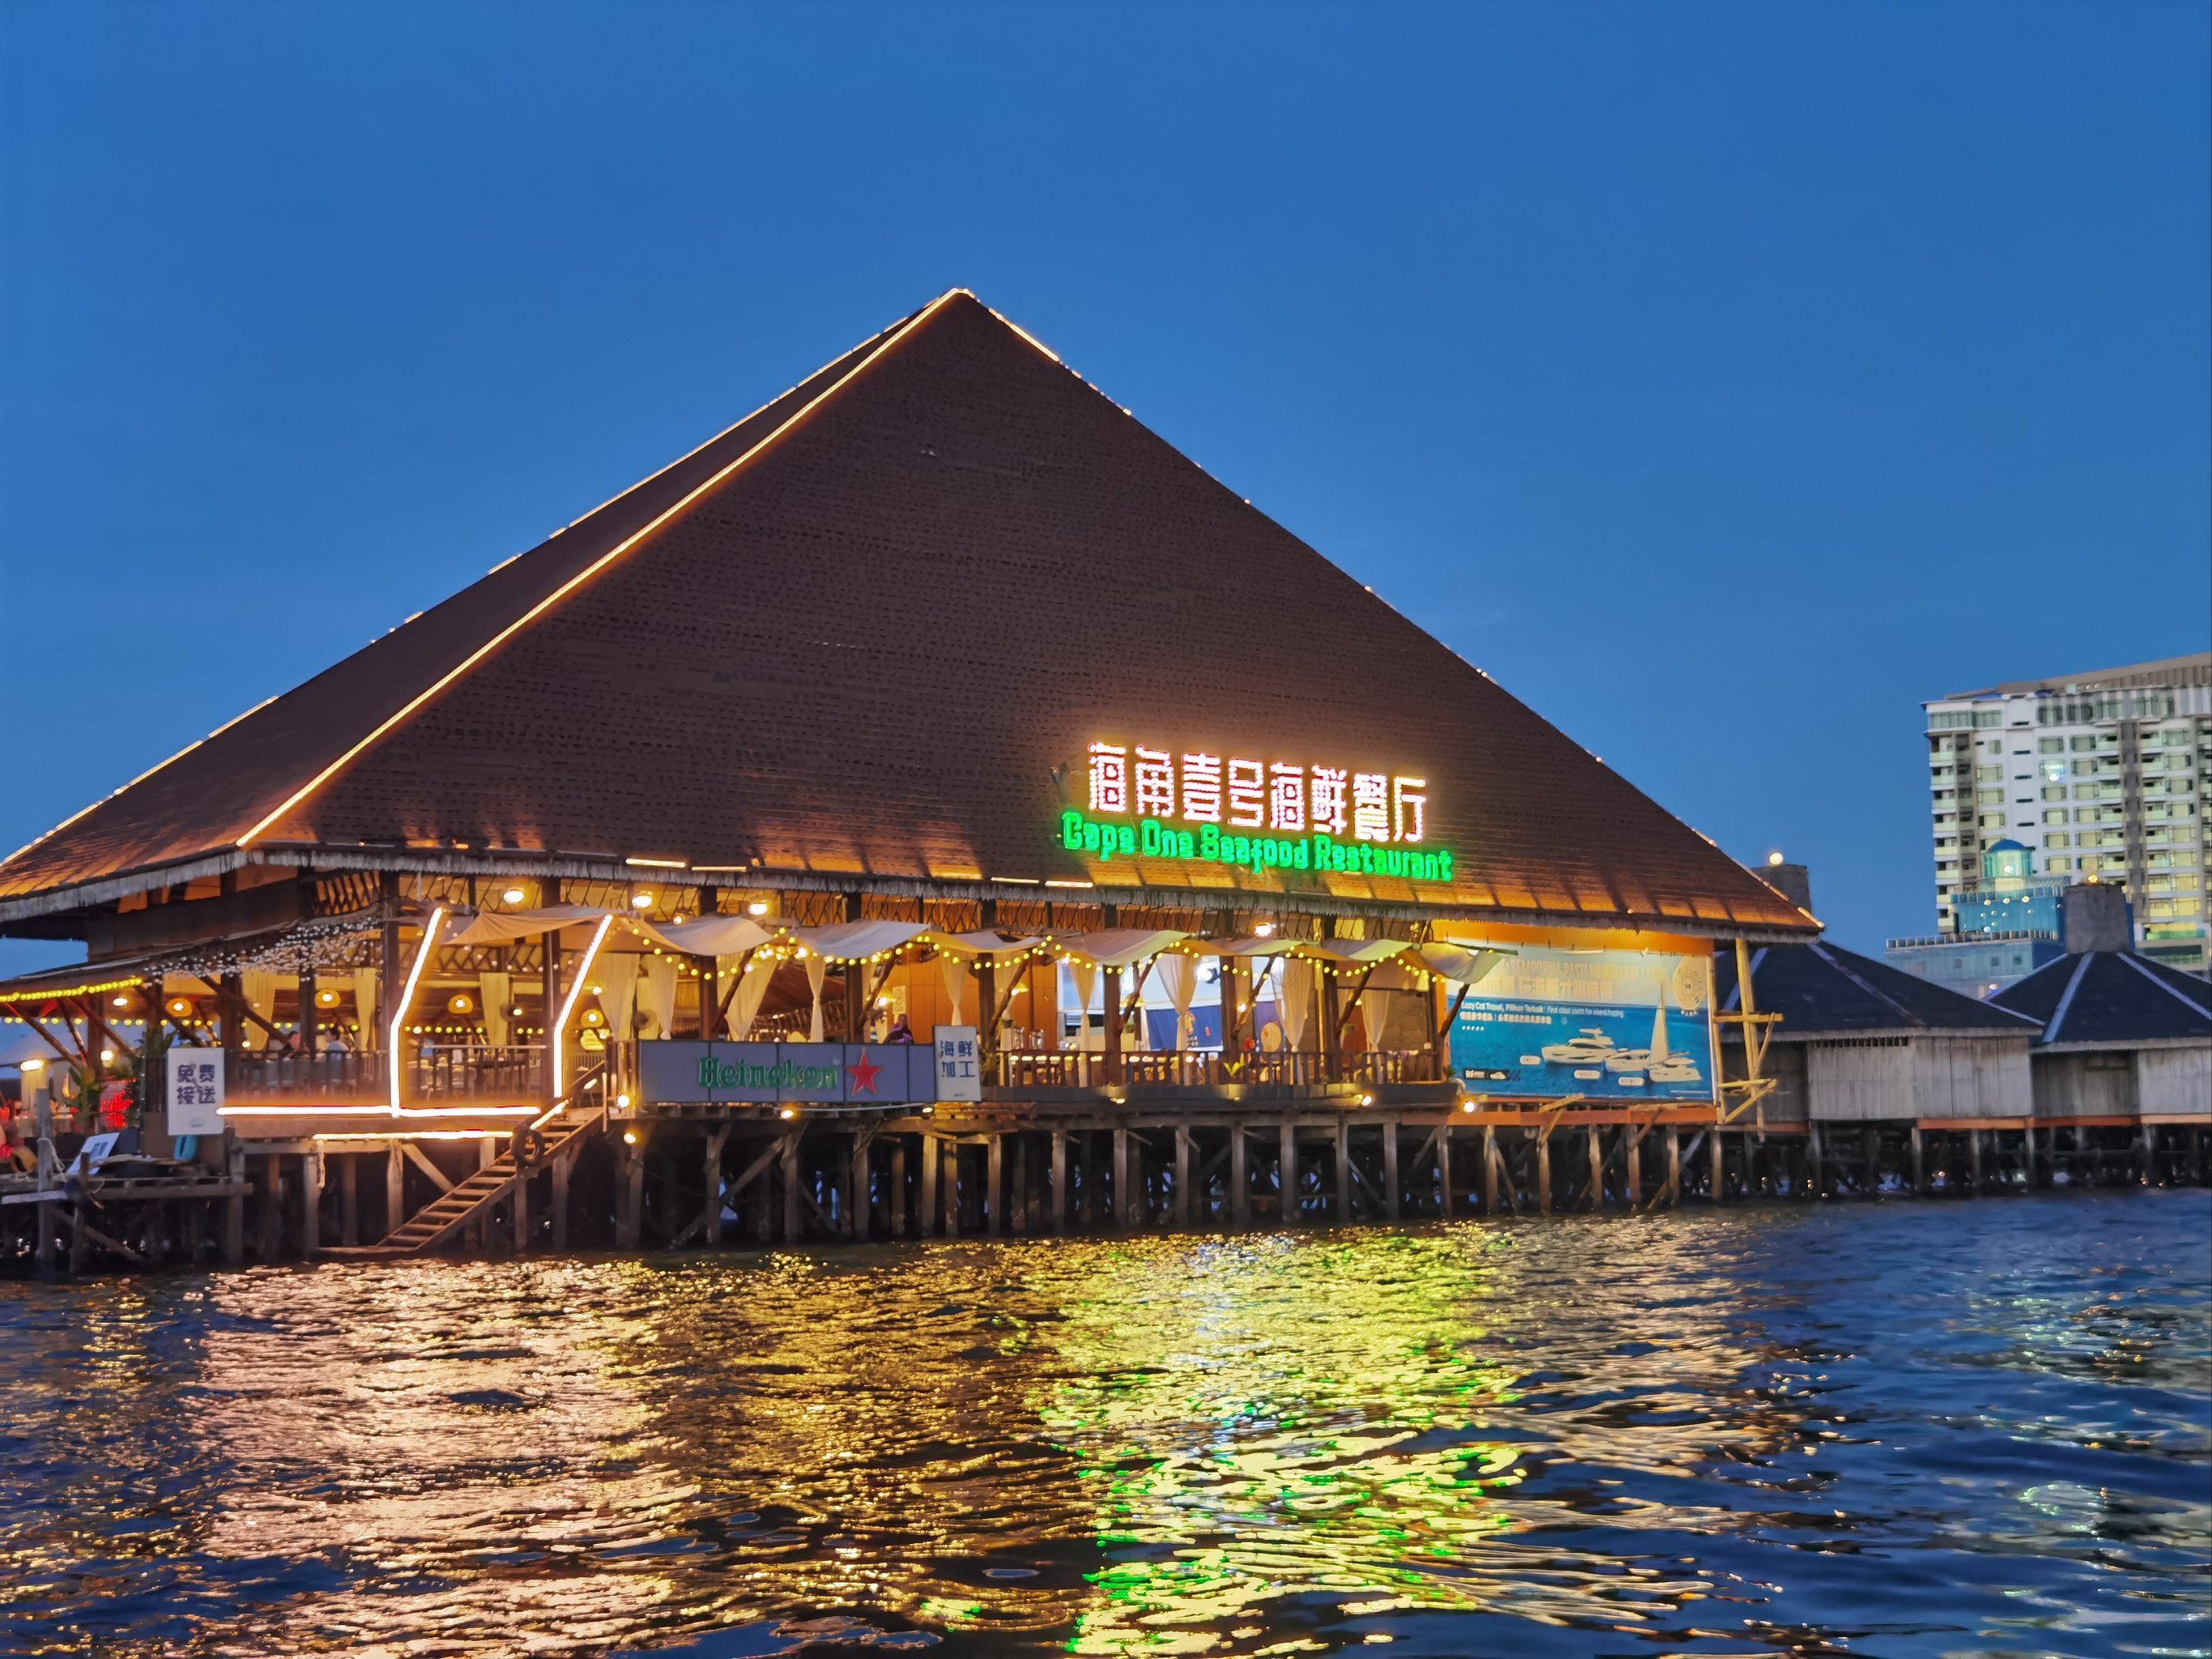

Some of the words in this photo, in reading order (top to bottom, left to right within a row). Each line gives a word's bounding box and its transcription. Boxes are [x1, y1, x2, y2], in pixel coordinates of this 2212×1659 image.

[1062, 811, 1135, 861] Cape
[1140, 819, 1194, 859] One
[1200, 823, 1308, 874] Seafood
[1313, 834, 1453, 882] Restaurant
[698, 1057, 837, 1090] Heineken
[941, 1060, 975, 1077] 加工
[177, 1085, 216, 1105] 接送
